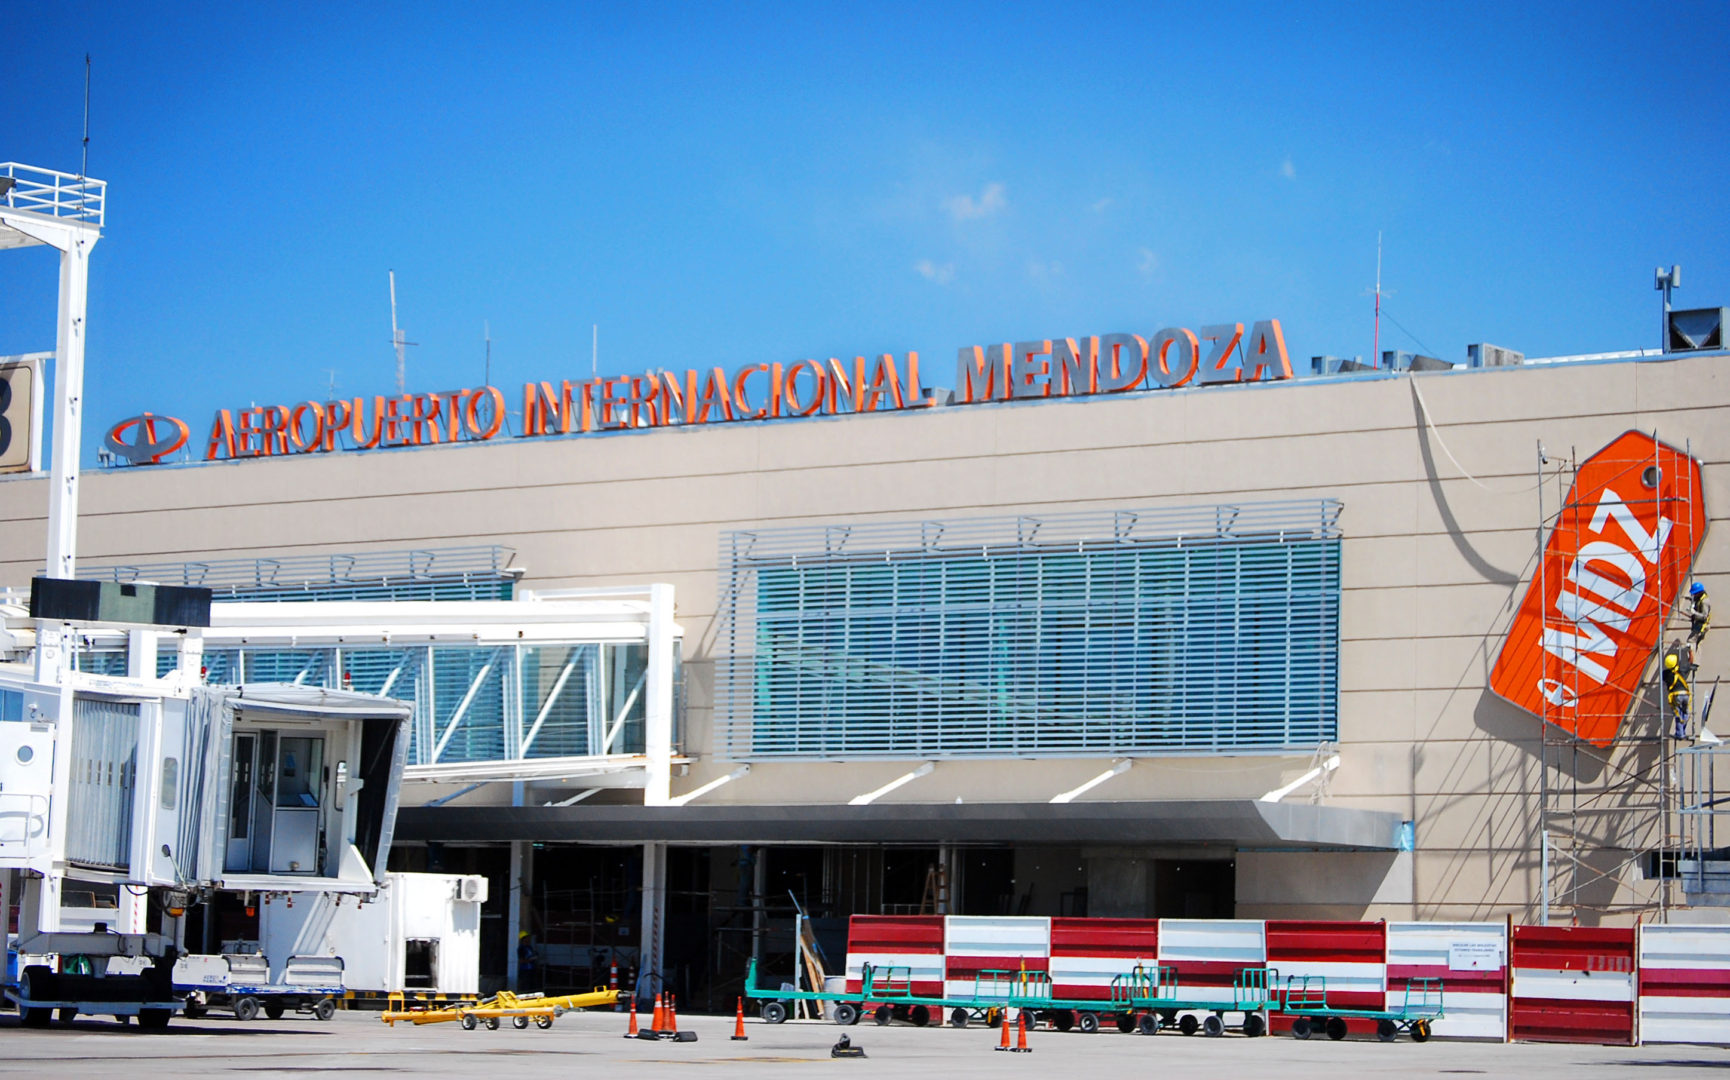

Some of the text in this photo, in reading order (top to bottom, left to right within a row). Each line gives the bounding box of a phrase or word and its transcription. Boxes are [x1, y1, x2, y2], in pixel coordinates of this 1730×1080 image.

[207, 319, 1294, 460] AEROPUERTO INTERNACIONAL MENDOZA
[1538, 487, 1675, 686] MDZ
